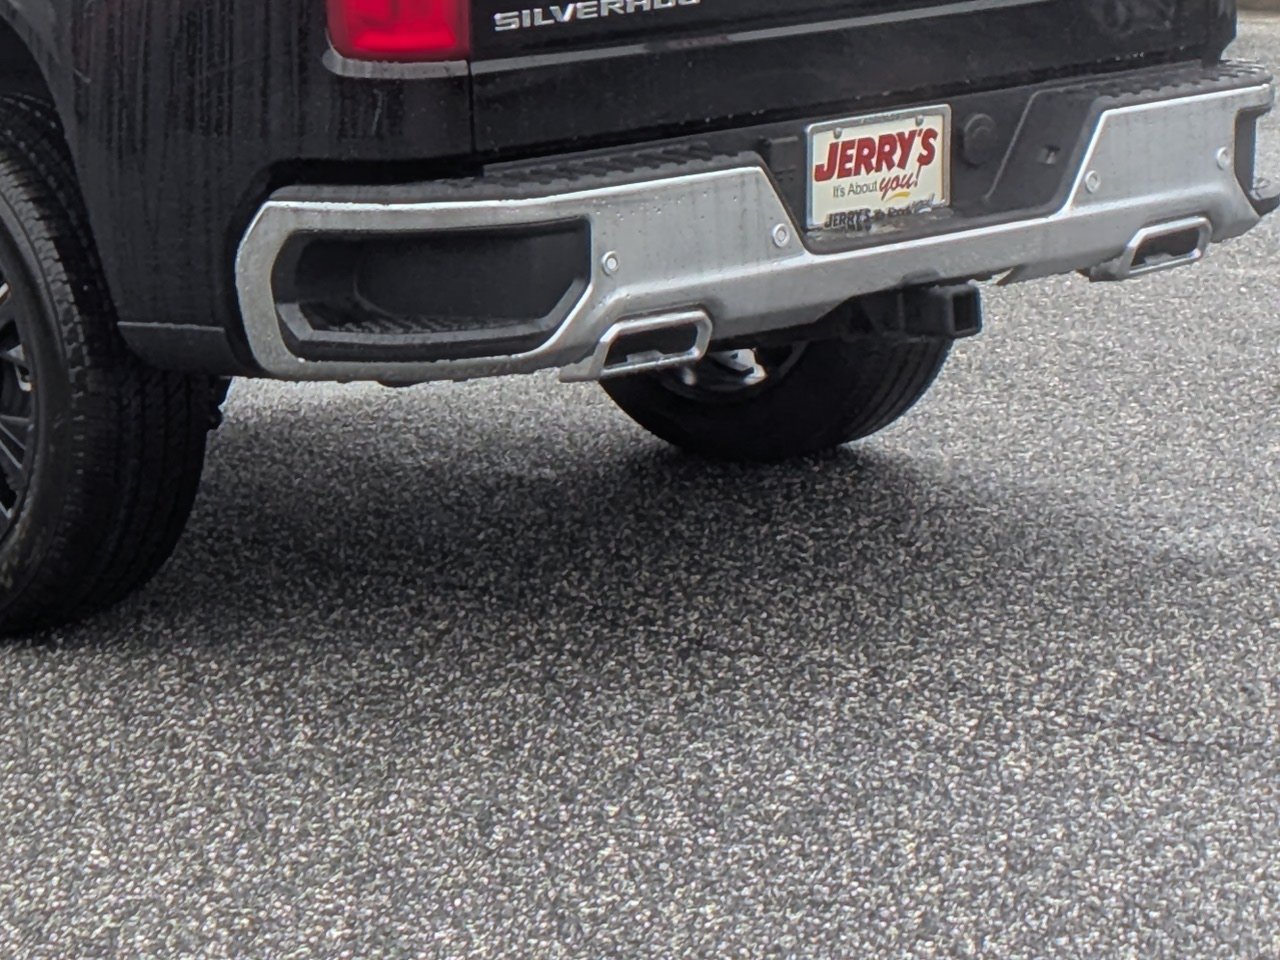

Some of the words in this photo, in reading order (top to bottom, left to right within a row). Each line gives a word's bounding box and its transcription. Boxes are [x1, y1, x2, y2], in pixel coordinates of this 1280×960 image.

[814, 127, 938, 182] JERRY'S
[833, 184, 846, 198] It's
[847, 180, 878, 195] About
[879, 165, 920, 201] you!
